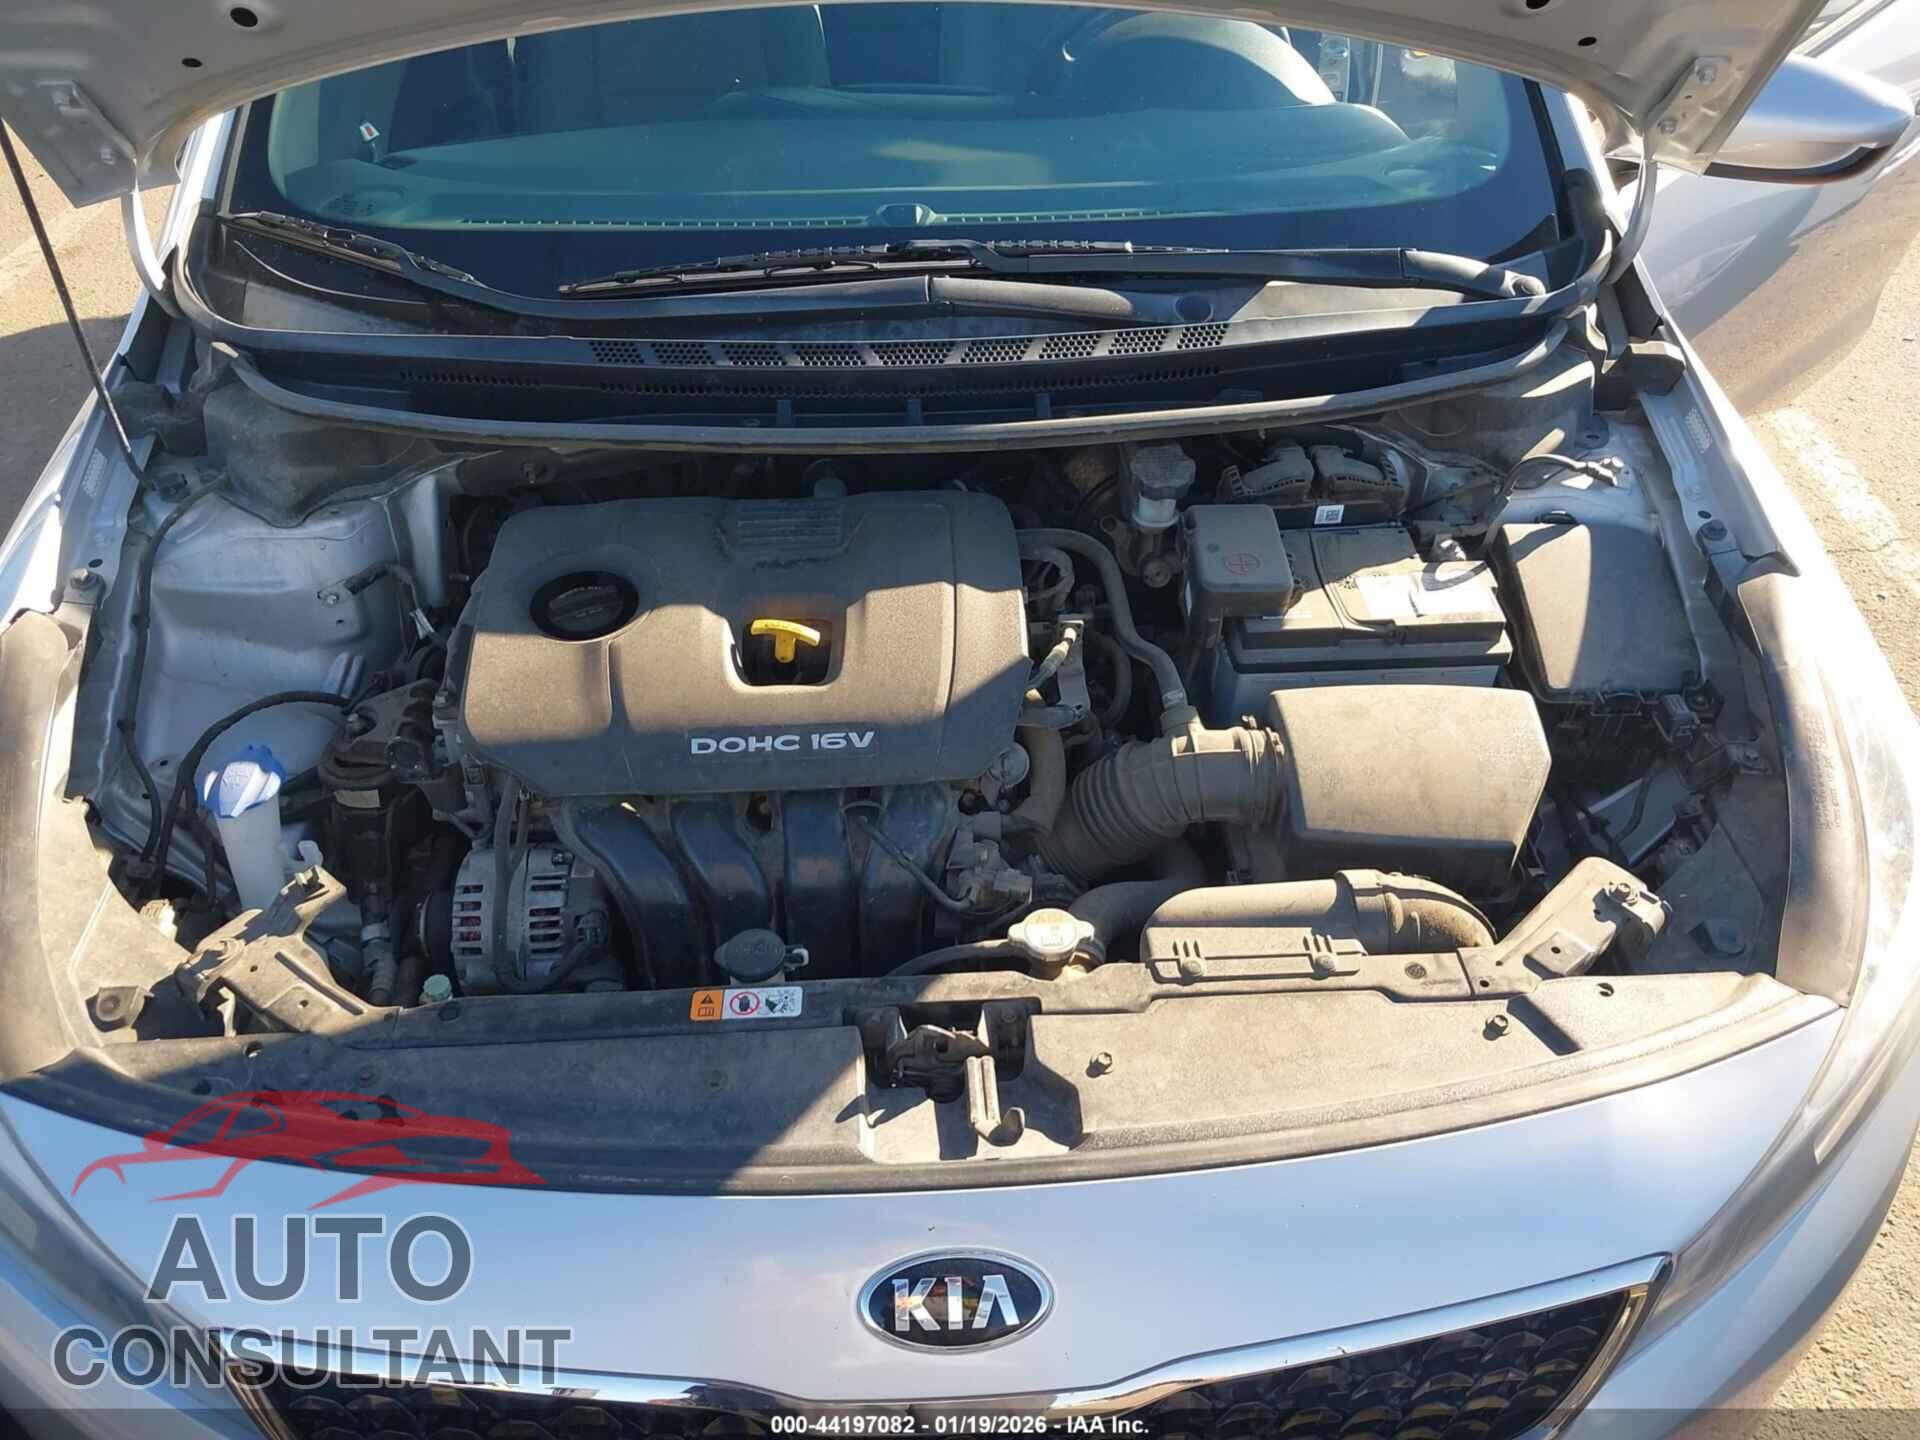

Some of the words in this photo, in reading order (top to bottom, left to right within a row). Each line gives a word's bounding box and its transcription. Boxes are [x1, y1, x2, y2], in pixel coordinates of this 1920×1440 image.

[690, 735, 801, 754] DOHC
[810, 731, 875, 750] 16V
[892, 1275, 1020, 1331] KIA
